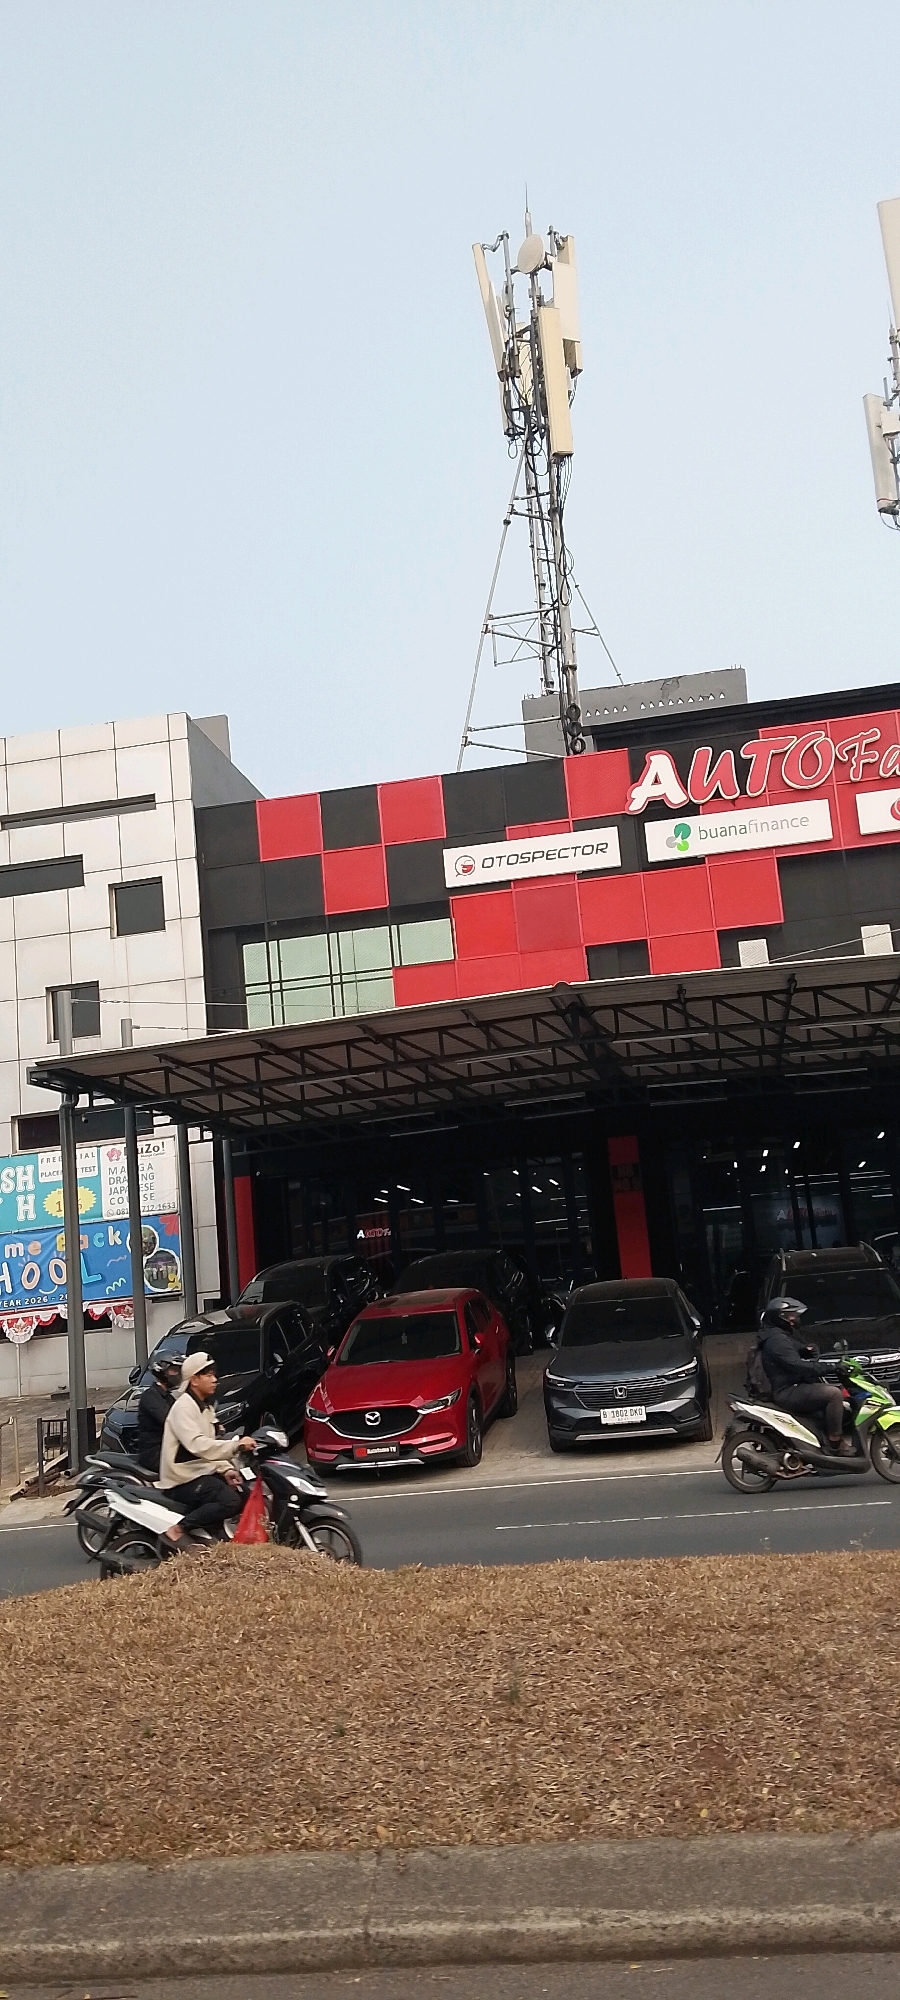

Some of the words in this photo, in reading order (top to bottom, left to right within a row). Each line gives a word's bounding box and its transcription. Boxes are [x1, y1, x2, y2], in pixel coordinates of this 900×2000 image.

[698, 814, 809, 840] buanafinance
[481, 842, 608, 869] OTOSPECTOR
[80, 1165, 96, 1174] TEST
[108, 1162, 153, 1175] MAGA
[108, 1172, 155, 1185] DRANG
[108, 1181, 155, 1196] JAPESE
[109, 1192, 155, 1205] COSE
[24, 1295, 48, 1305] 2026
